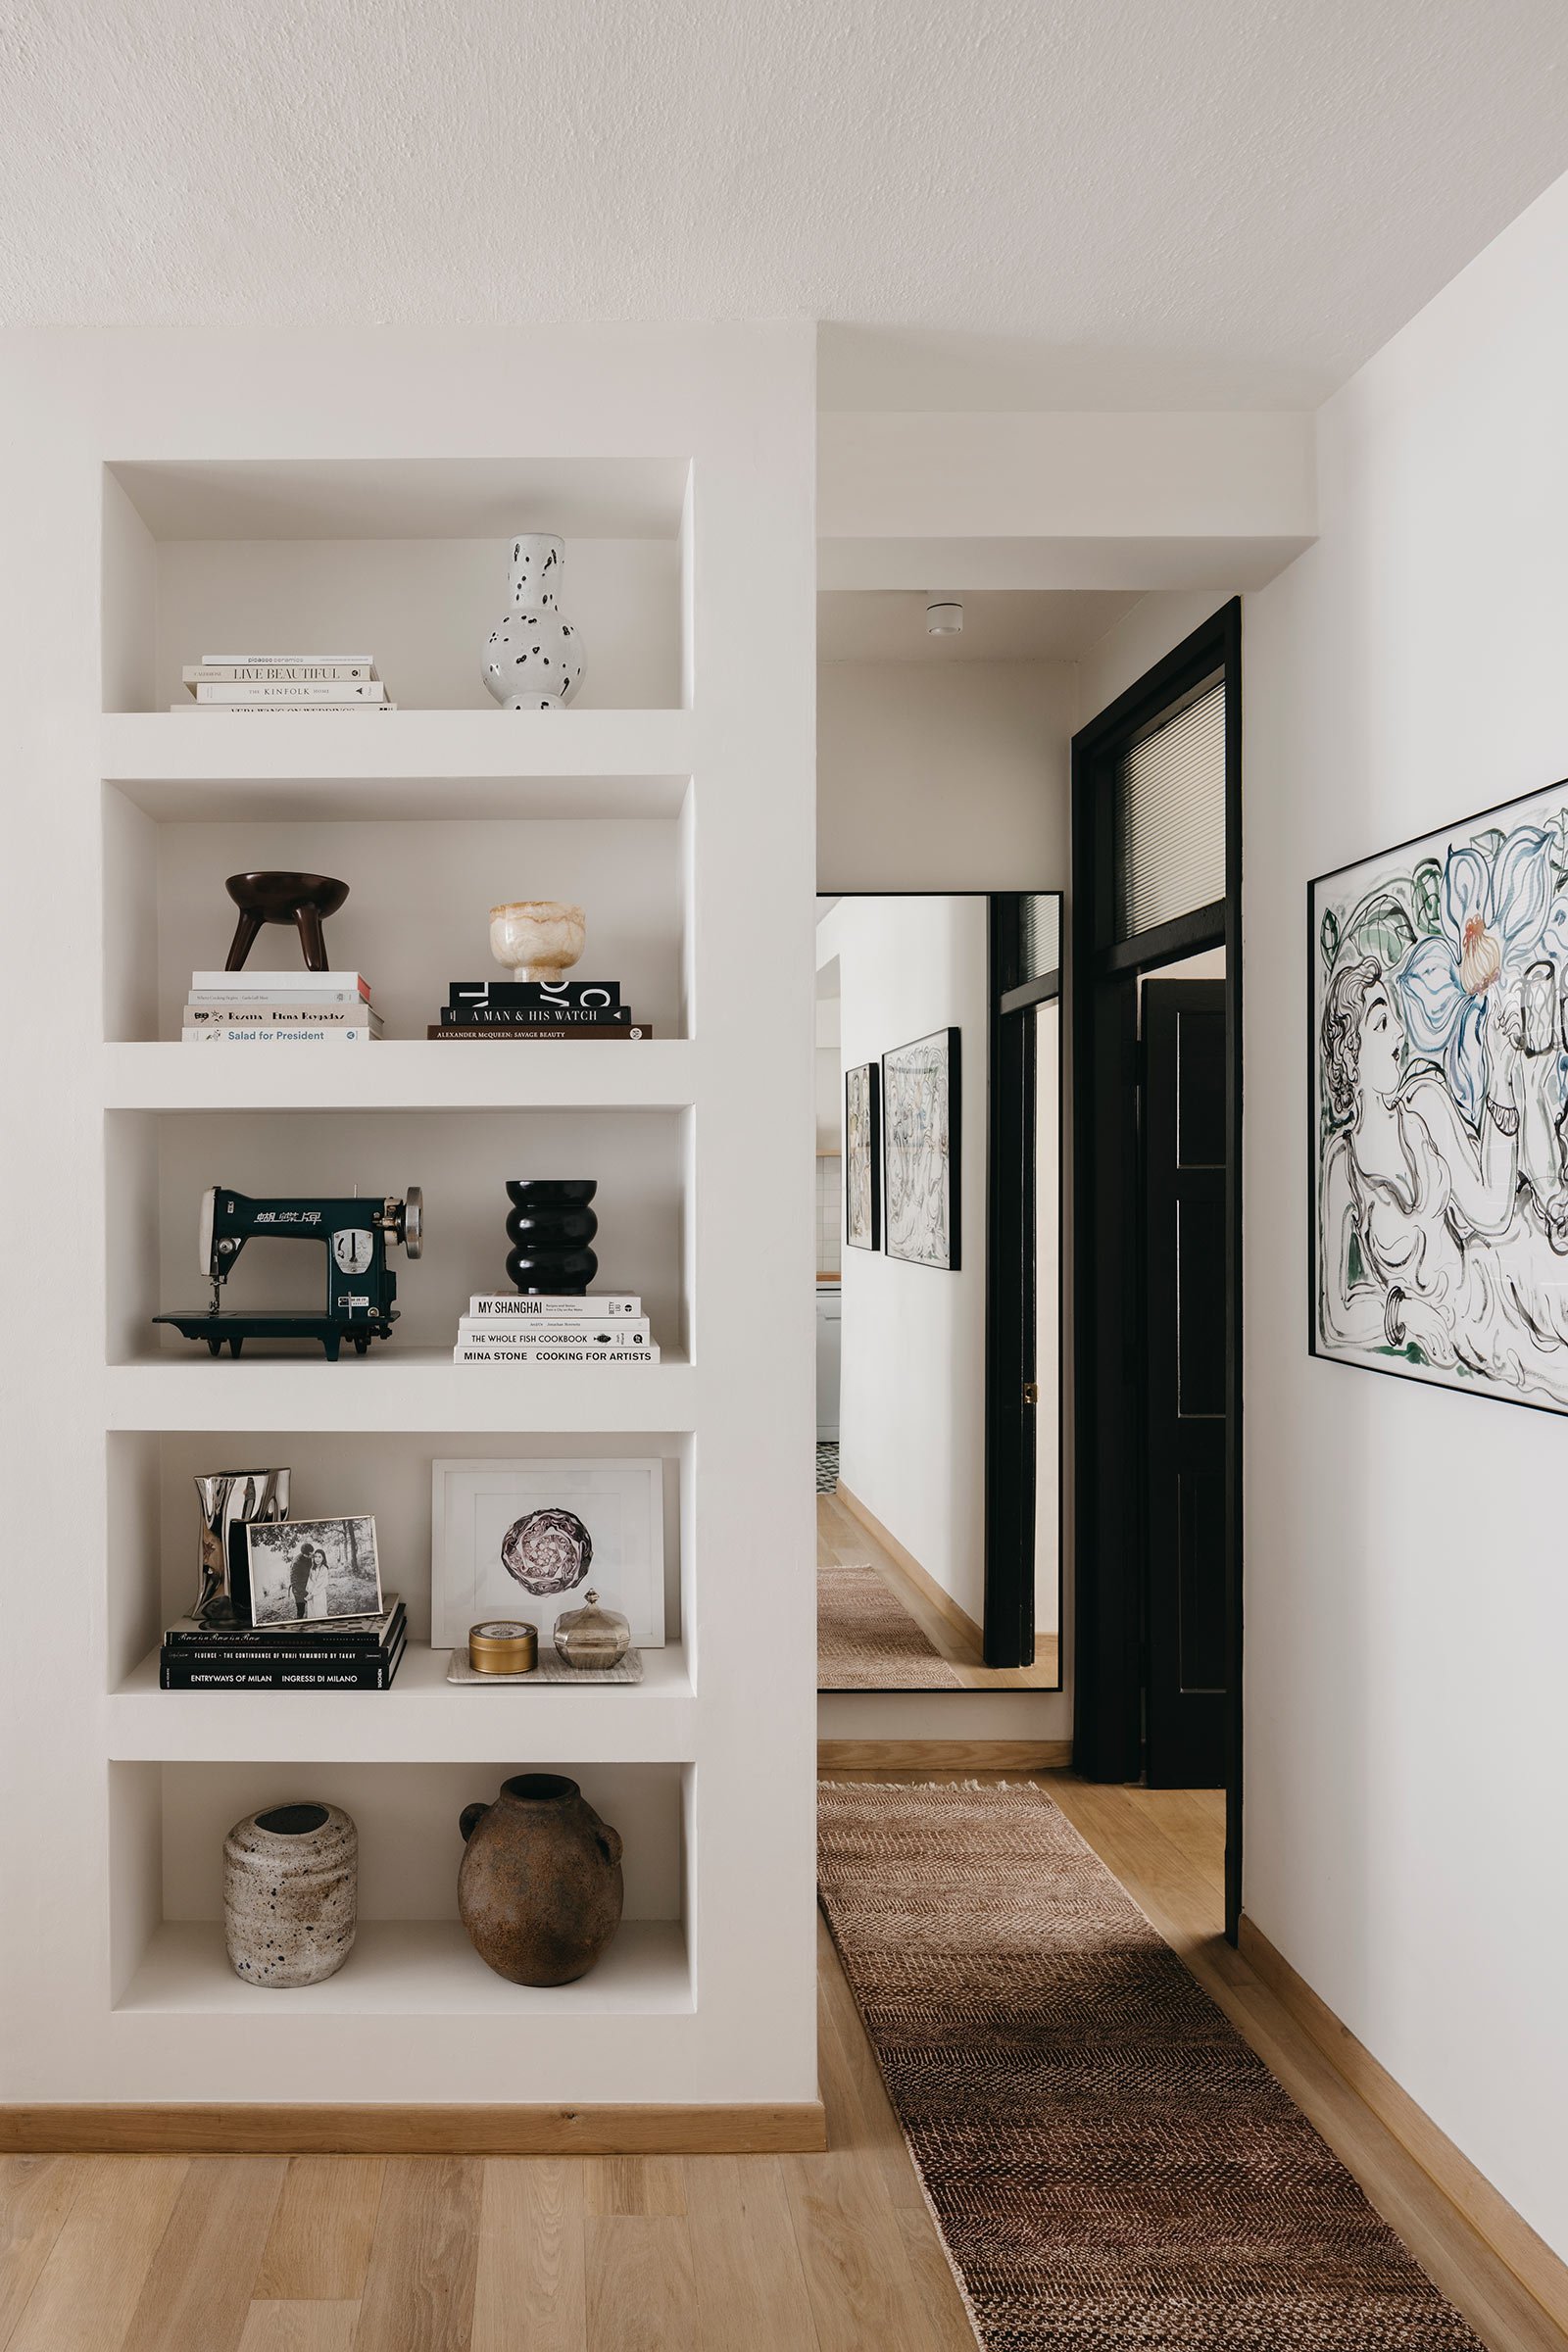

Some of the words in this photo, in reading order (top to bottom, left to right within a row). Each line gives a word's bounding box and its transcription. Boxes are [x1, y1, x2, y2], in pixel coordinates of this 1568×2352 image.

[233, 668, 263, 680] LIVE
[267, 667, 340, 679] BEAUTIFUL
[228, 1011, 263, 1021] Rosetta
[272, 1011, 299, 1021] Elena
[302, 1011, 345, 1022] Reygadas
[471, 1011, 479, 1021] A
[484, 1010, 511, 1021] MAN
[514, 1010, 524, 1021] &
[529, 1010, 550, 1021] HIS
[555, 1010, 598, 1021] WATCH
[228, 1030, 256, 1041] Salad
[259, 1030, 272, 1041] for
[276, 1030, 324, 1041] President
[477, 1301, 493, 1314] MY
[495, 1301, 542, 1314] SHANGHAI
